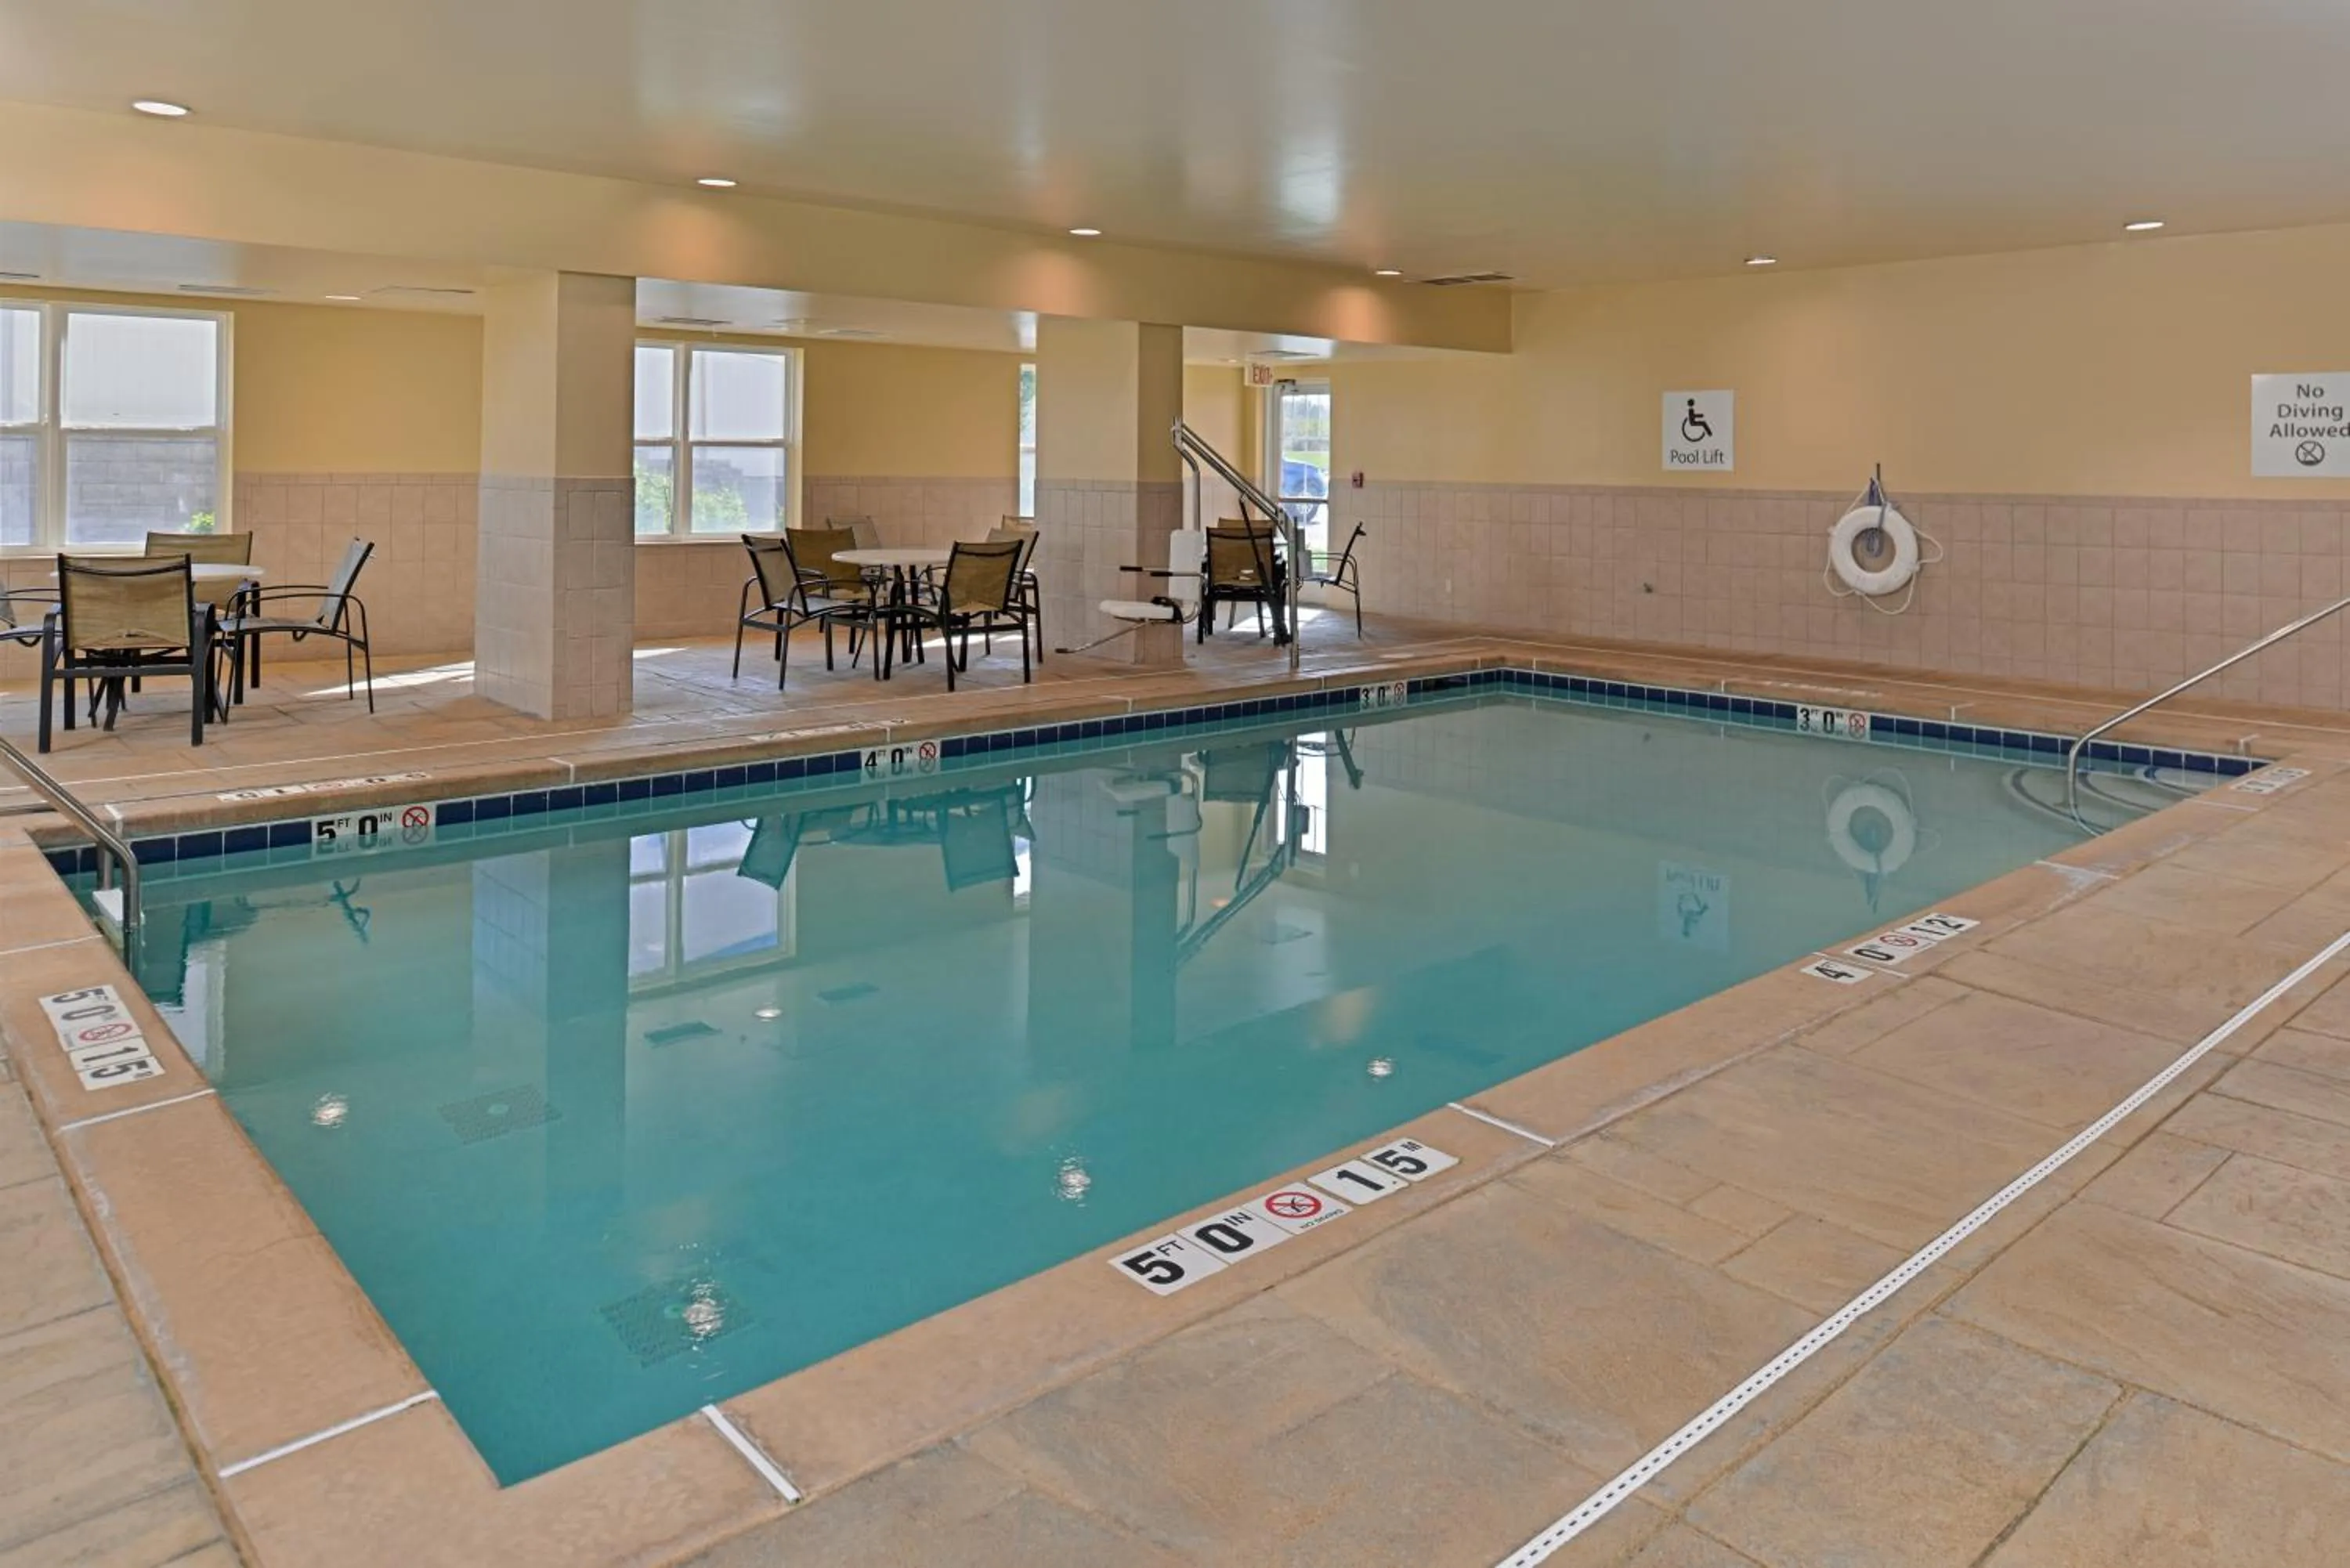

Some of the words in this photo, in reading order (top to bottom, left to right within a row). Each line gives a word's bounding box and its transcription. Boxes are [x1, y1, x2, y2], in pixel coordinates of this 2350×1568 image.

[1253, 366, 1271, 384] EXIT
[2296, 383, 2325, 399] No
[2277, 403, 2343, 421] Diving
[2269, 421, 2350, 438] Allowed
[1670, 449, 1699, 464] Pool
[1703, 449, 1726, 464] Lift
[865, 751, 877, 767] 4
[316, 820, 336, 840] 5
[52, 988, 105, 1003] 5
[61, 1005, 116, 1021] 0
[1224, 1212, 1253, 1227] IN
[1195, 1223, 1254, 1253] 0
[1155, 1240, 1184, 1256] FT
[1122, 1251, 1185, 1284] 5
